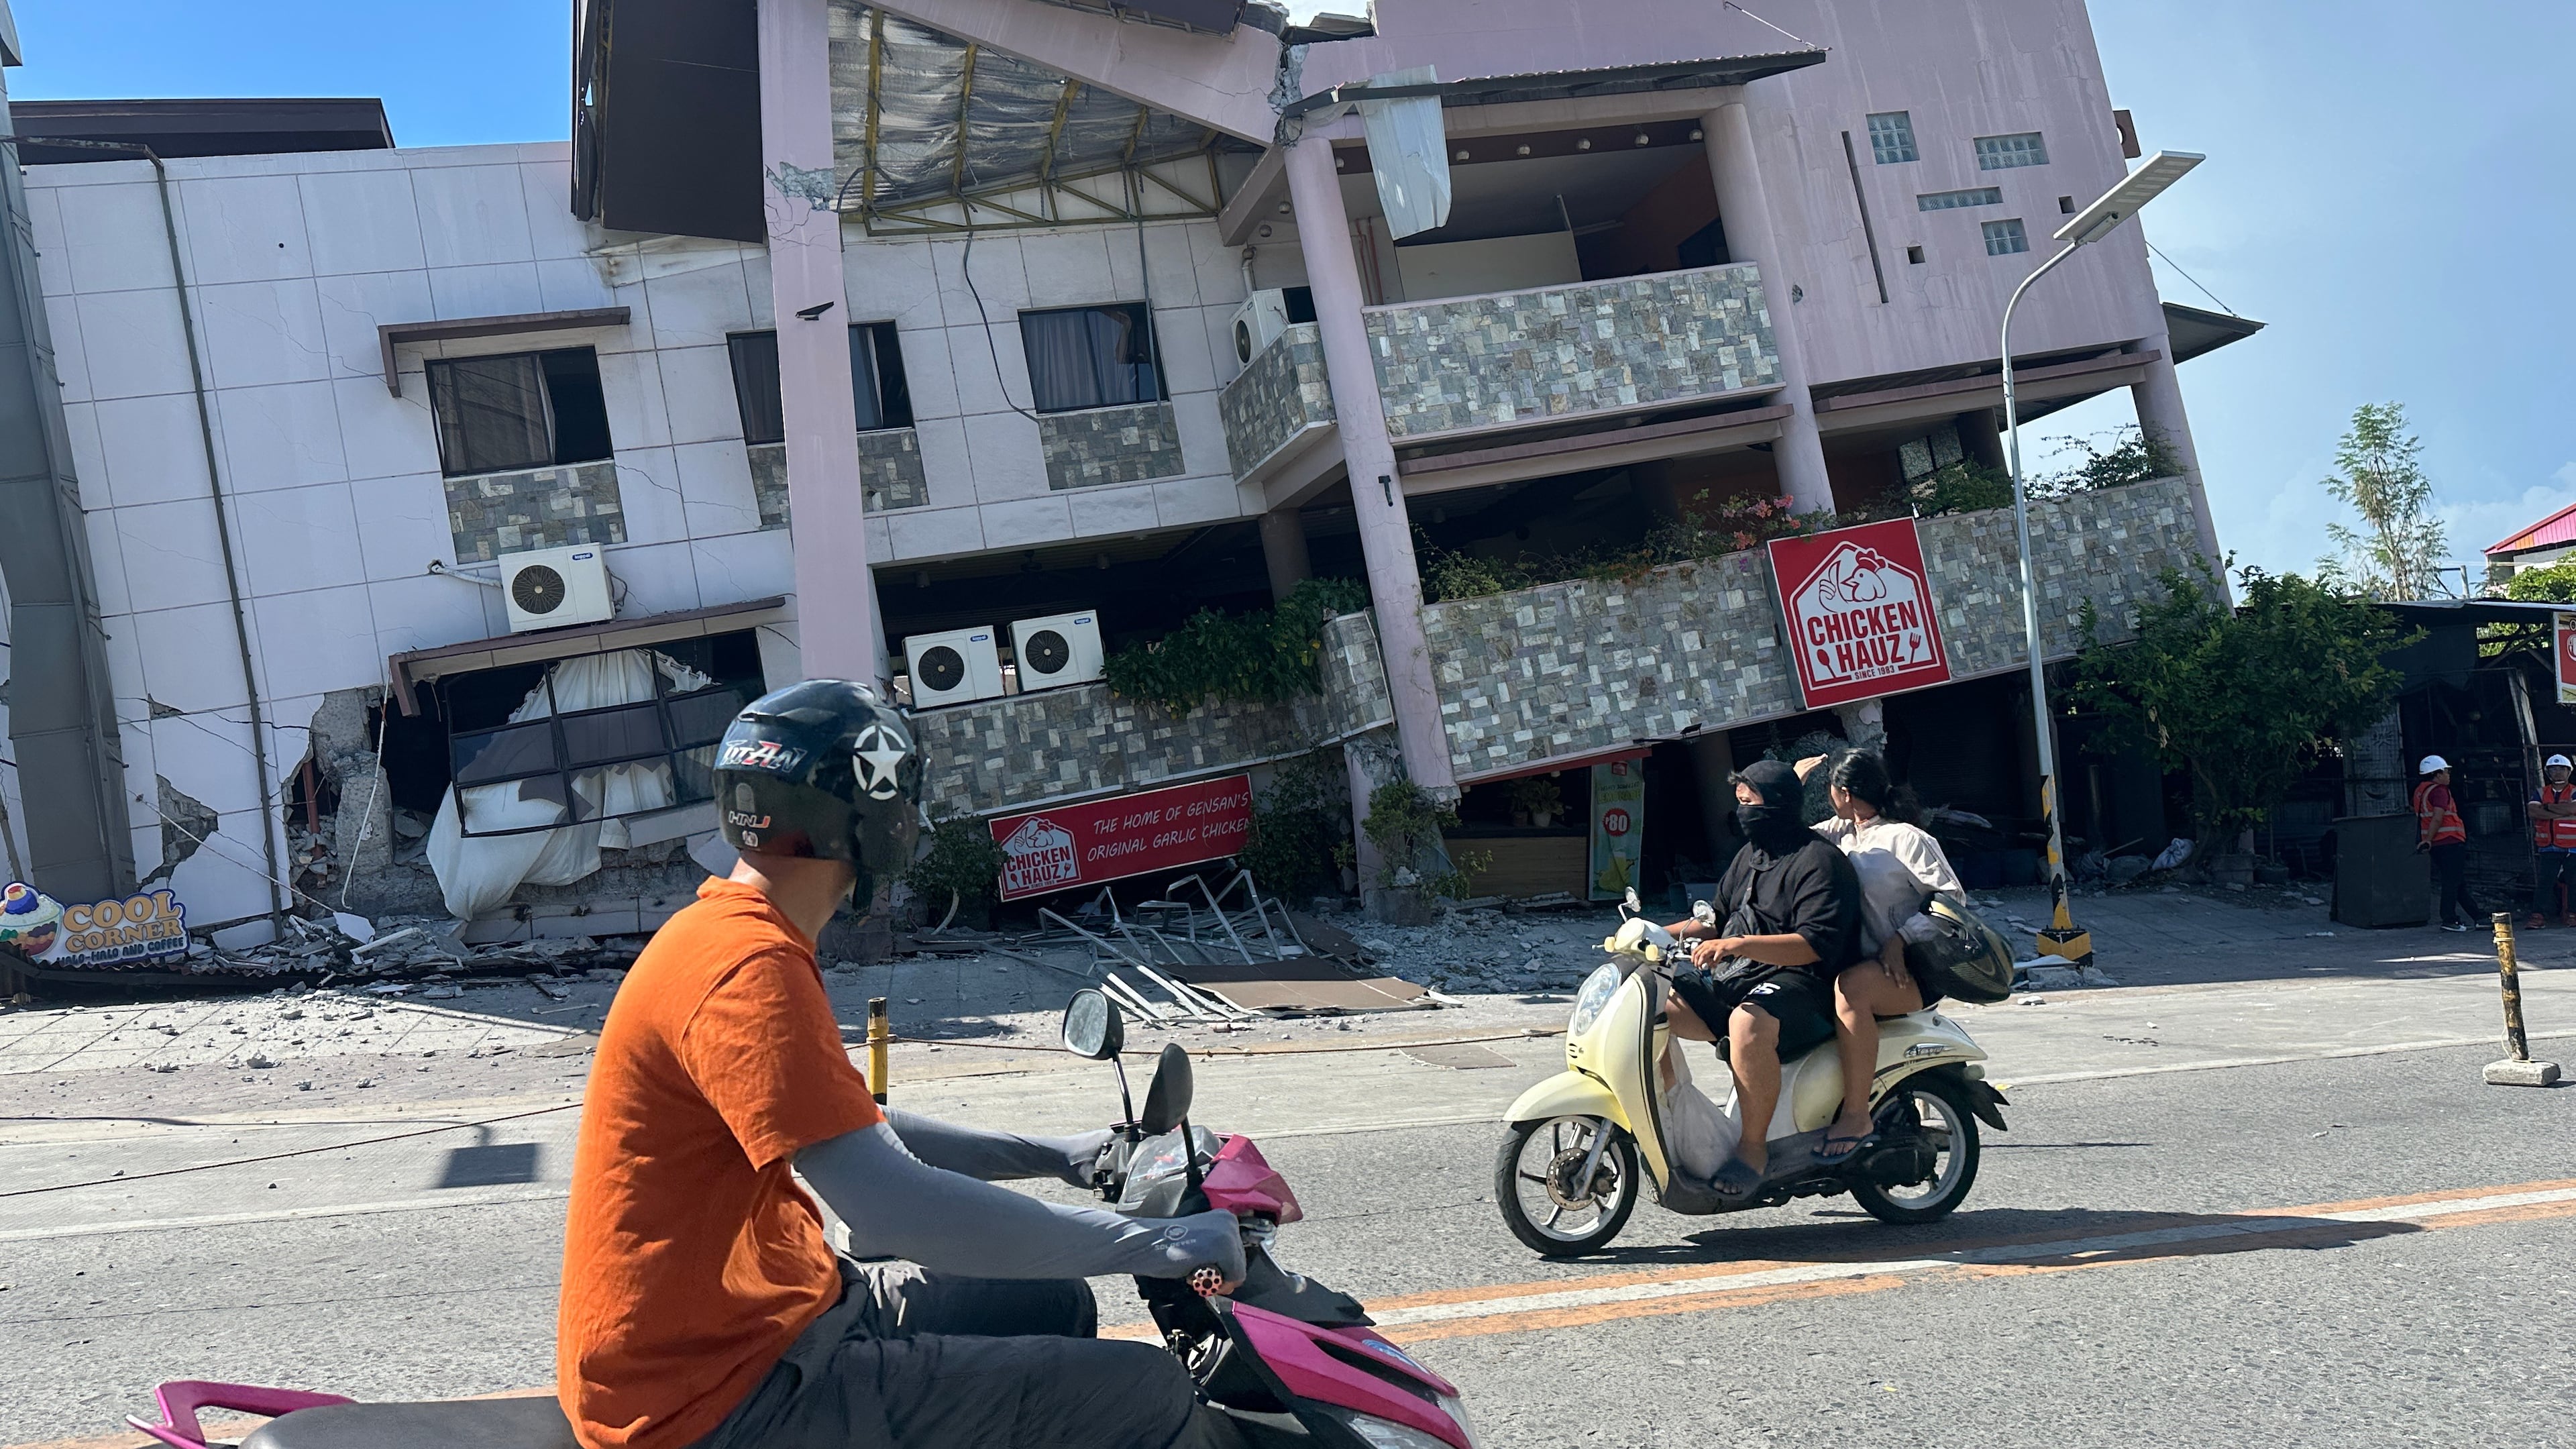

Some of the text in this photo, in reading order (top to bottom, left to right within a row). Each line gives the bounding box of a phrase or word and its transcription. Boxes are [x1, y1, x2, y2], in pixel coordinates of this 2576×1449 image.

[1807, 600, 1919, 646] CHICKEN
[1836, 634, 1904, 673] HAUZ
[1855, 665, 1894, 680] SINCE 1983
[1093, 792, 1249, 835] THE HOME OF GENSAN'S
[1006, 845, 1071, 872] CHICKEN
[1087, 837, 1147, 862] ORIGINAL
[1152, 828, 1196, 849] GARLIC
[1021, 863, 1061, 885] HAUZ
[63, 891, 180, 932] COOL
[65, 918, 183, 952] CORNER
[123, 944, 144, 956] AND
[148, 936, 184, 952] COFFEE
